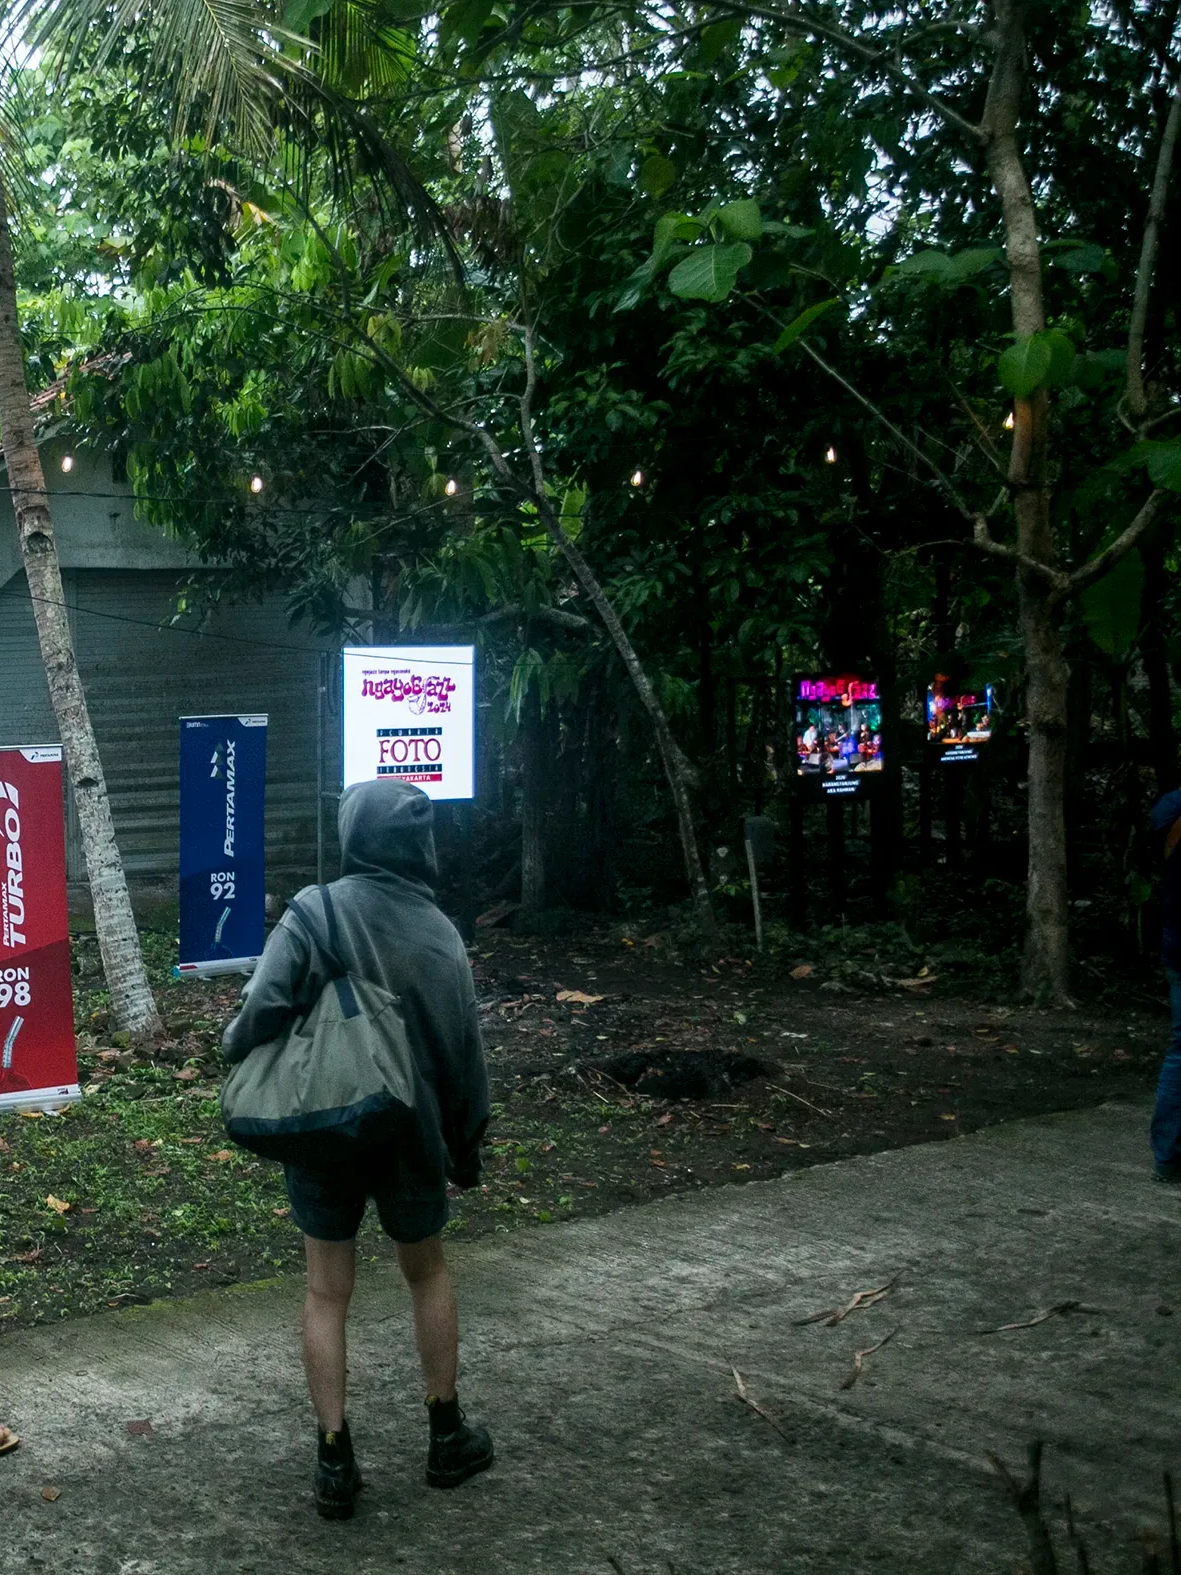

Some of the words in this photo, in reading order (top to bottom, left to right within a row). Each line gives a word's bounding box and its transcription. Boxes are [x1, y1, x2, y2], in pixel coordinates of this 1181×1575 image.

[379, 738, 441, 763] FOTO
[223, 739, 236, 857] PERTAMAX
[4, 807, 27, 948] TURBO
[210, 872, 235, 882] RON
[210, 882, 235, 900] 92
[0, 882, 10, 947] PERTAMAX
